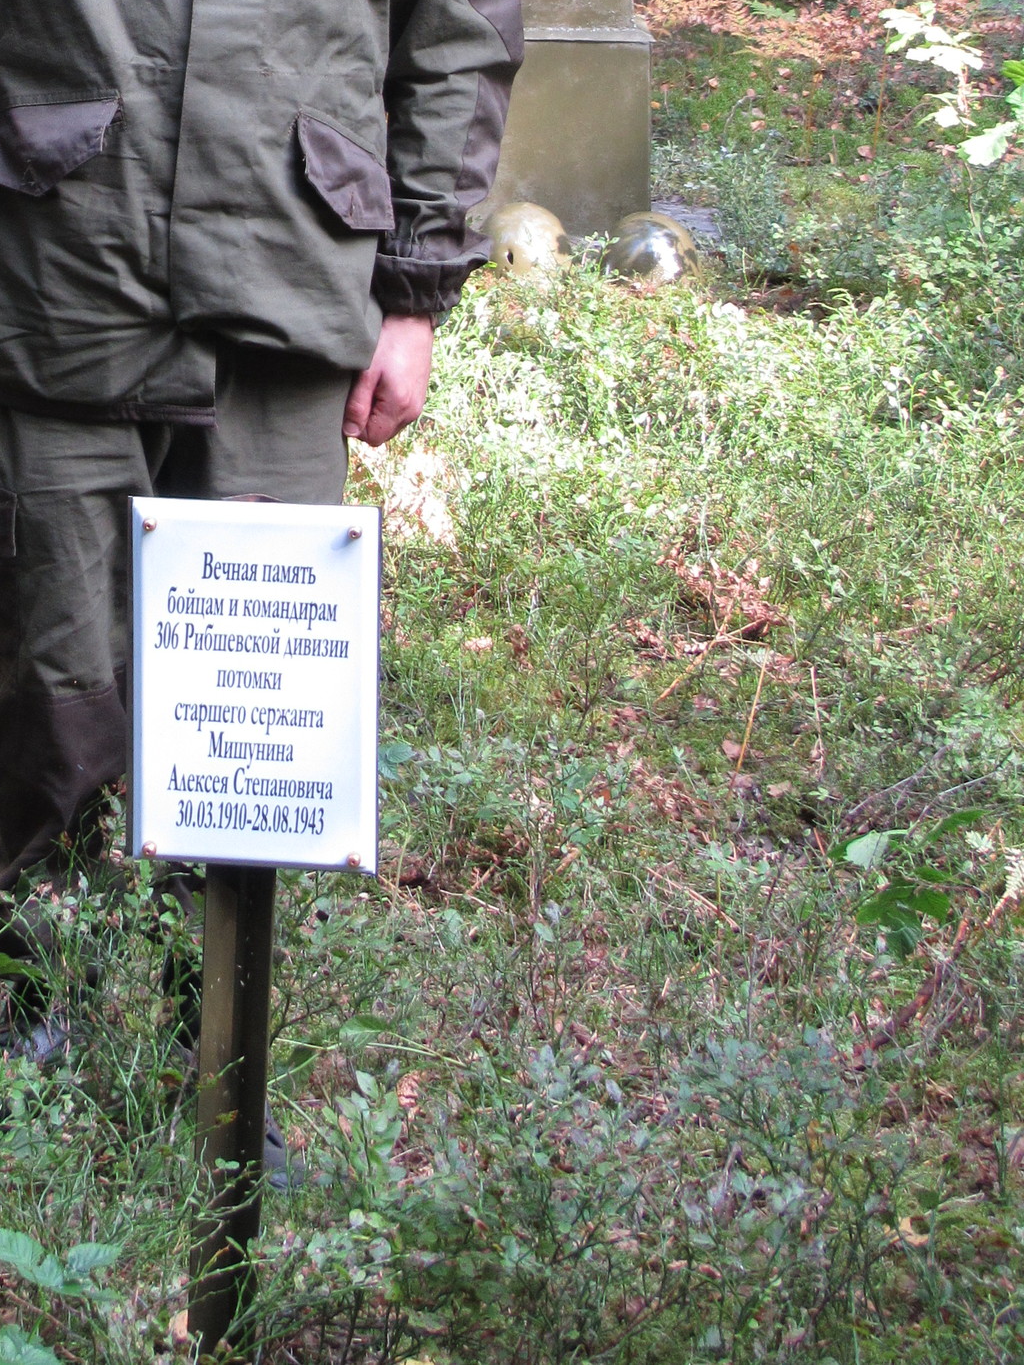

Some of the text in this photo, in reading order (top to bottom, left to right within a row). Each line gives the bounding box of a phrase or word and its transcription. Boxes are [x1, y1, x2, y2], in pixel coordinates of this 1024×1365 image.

[201, 552, 317, 585] Вечная память
[167, 586, 338, 630] бойцам и командирам
[154, 621, 350, 659] 306 Рибшевской дивизии
[216, 669, 282, 690] потомки
[174, 701, 324, 735] старшего сержанта
[207, 731, 294, 769] Мишунина
[167, 763, 333, 800] Алексея Степановича
[175, 799, 325, 835] 30.03.1910-28.08.1943
